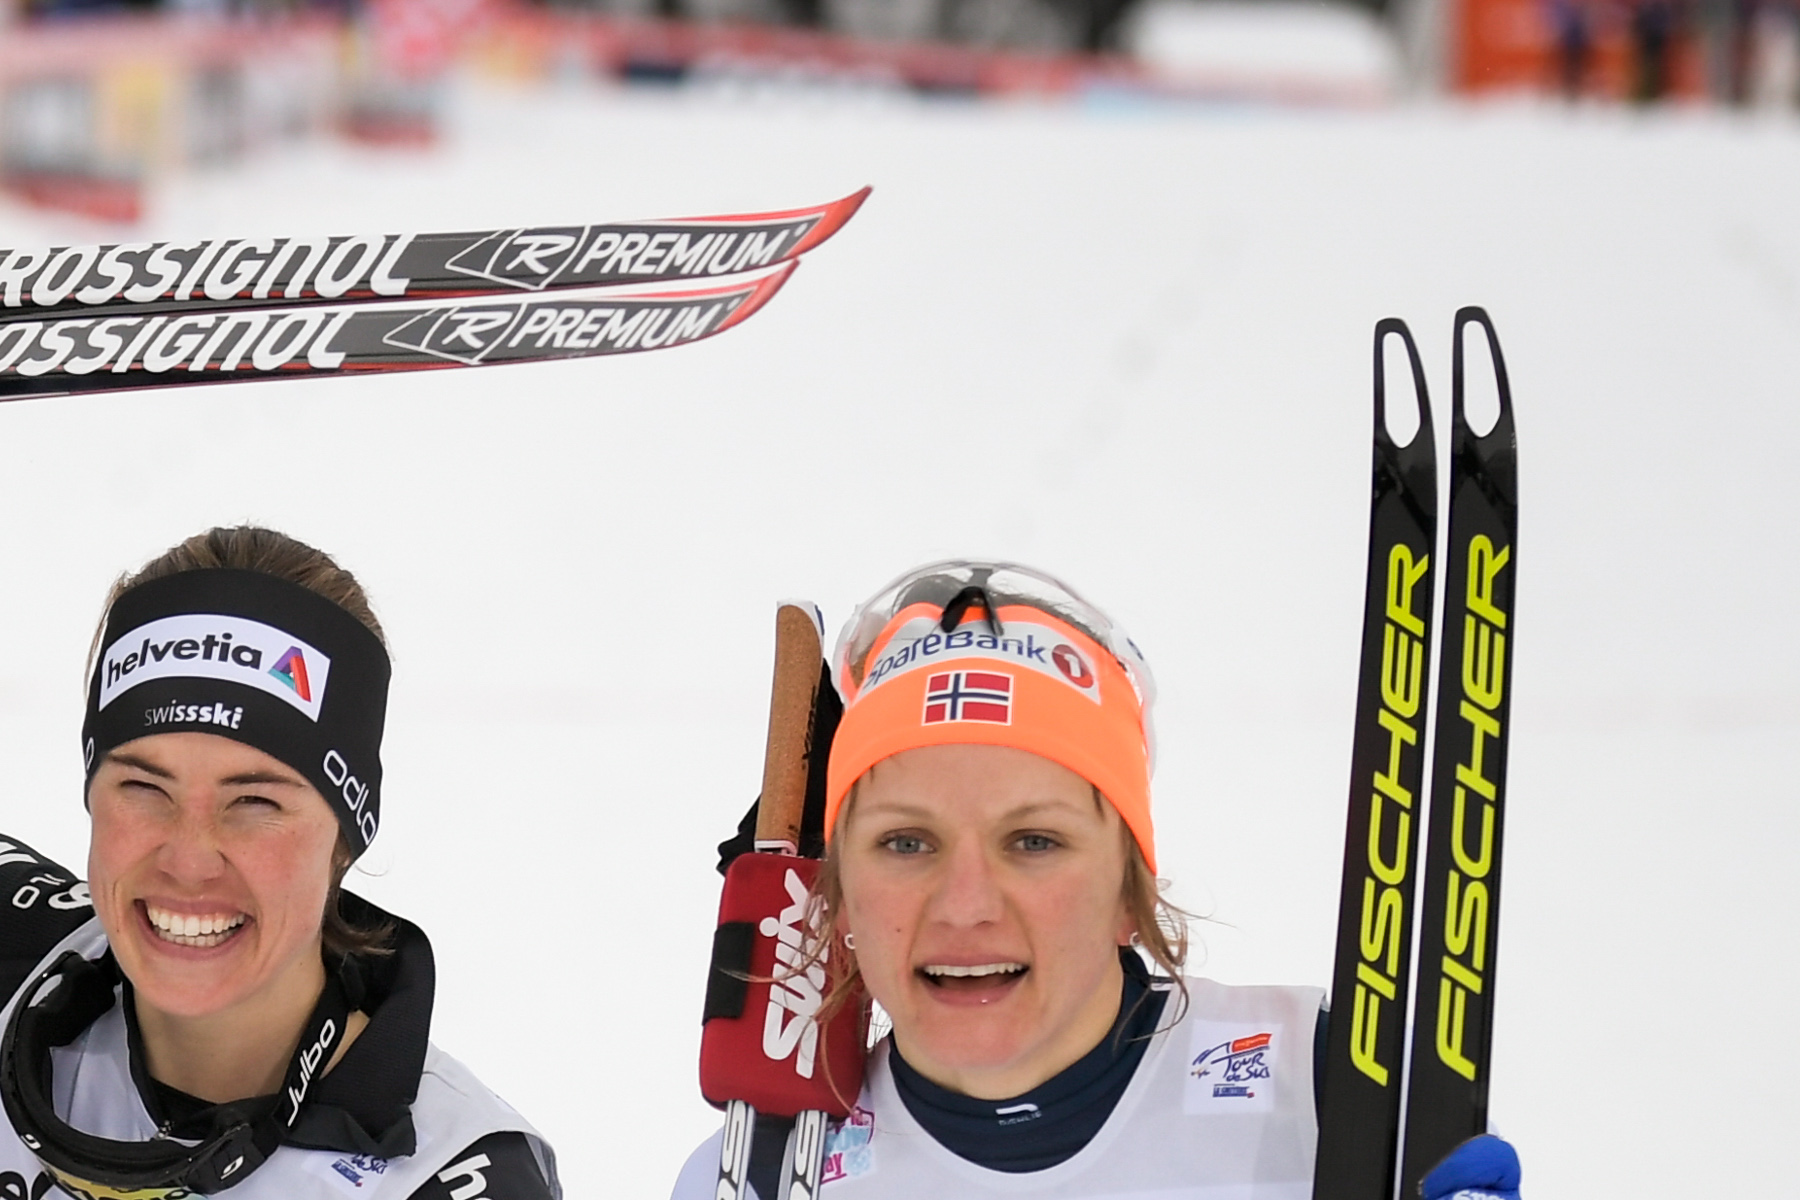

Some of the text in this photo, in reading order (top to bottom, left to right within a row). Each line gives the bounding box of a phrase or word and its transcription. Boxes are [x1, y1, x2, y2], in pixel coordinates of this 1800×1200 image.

[573, 231, 783, 275] PREMIUM
[508, 302, 717, 350] PREMIUM
[105, 631, 263, 690] helvetia
[143, 698, 244, 731] swissski
[322, 749, 378, 845] odlo
[1349, 542, 1430, 1088] FISCHER
[1435, 533, 1511, 1082] FISCHER
